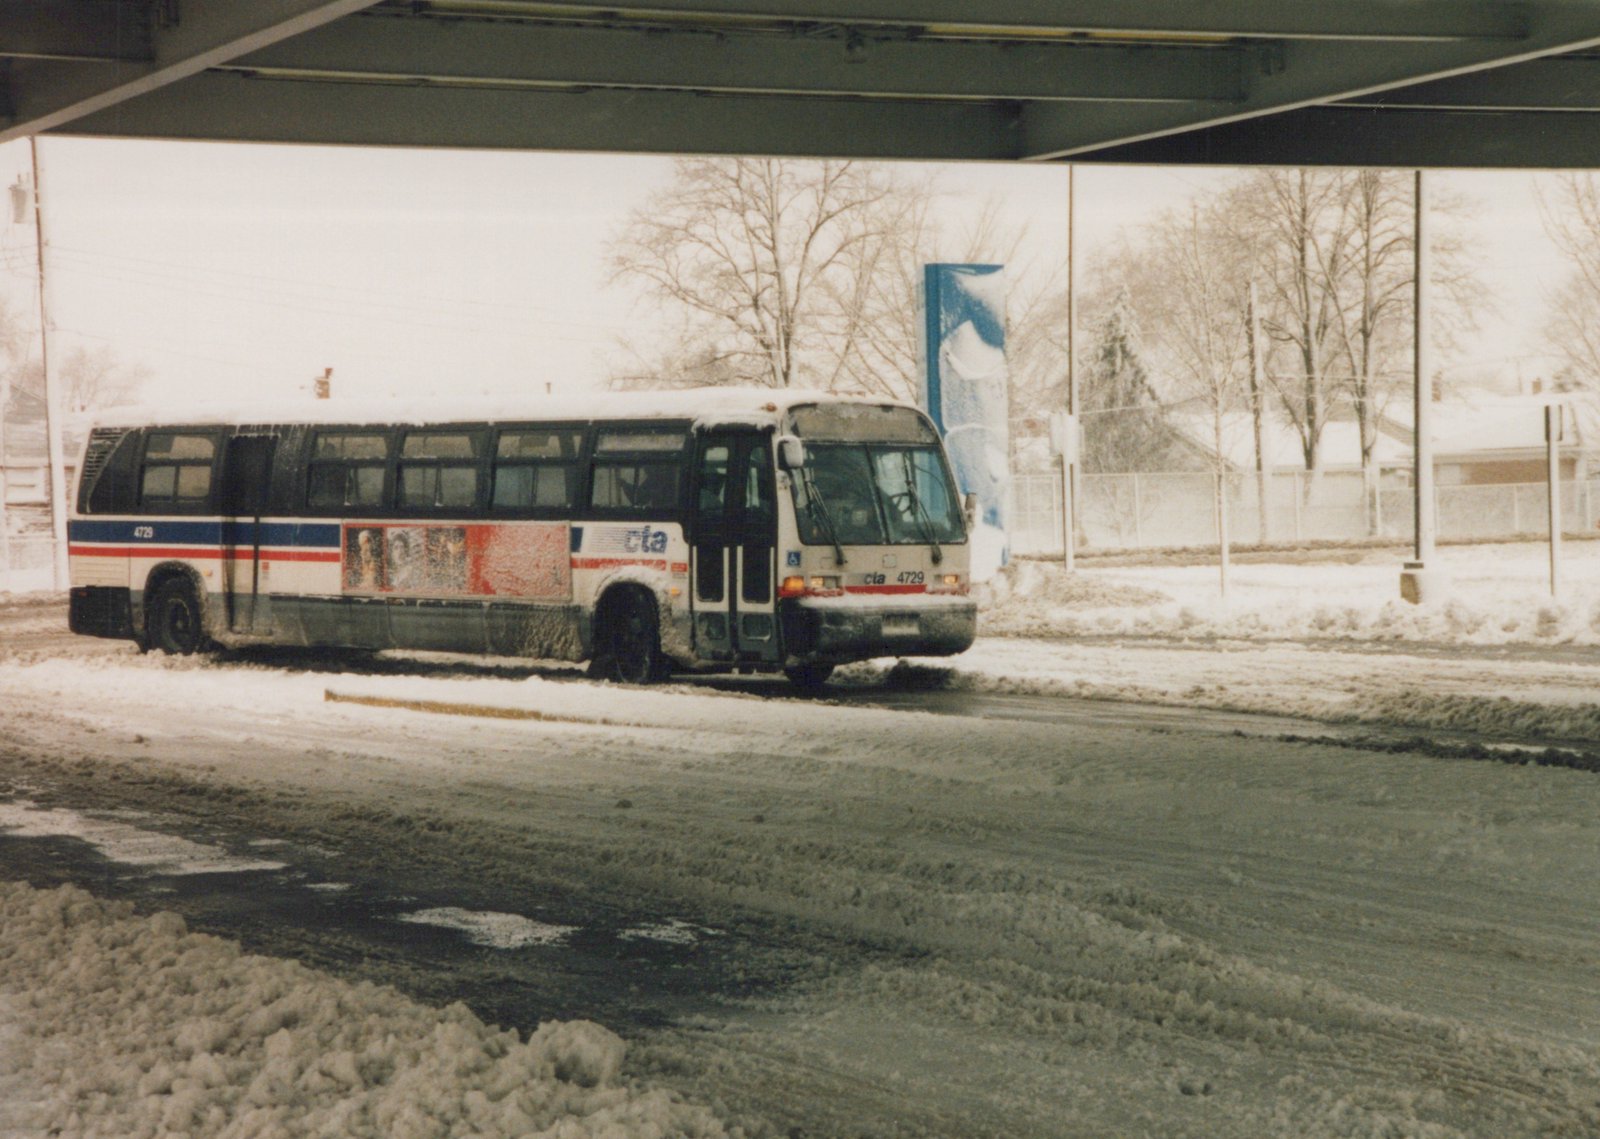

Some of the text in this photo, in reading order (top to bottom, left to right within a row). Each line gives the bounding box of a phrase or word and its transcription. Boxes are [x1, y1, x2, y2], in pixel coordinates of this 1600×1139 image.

[624, 525, 668, 553] cta
[864, 571, 925, 584] cta 4729
